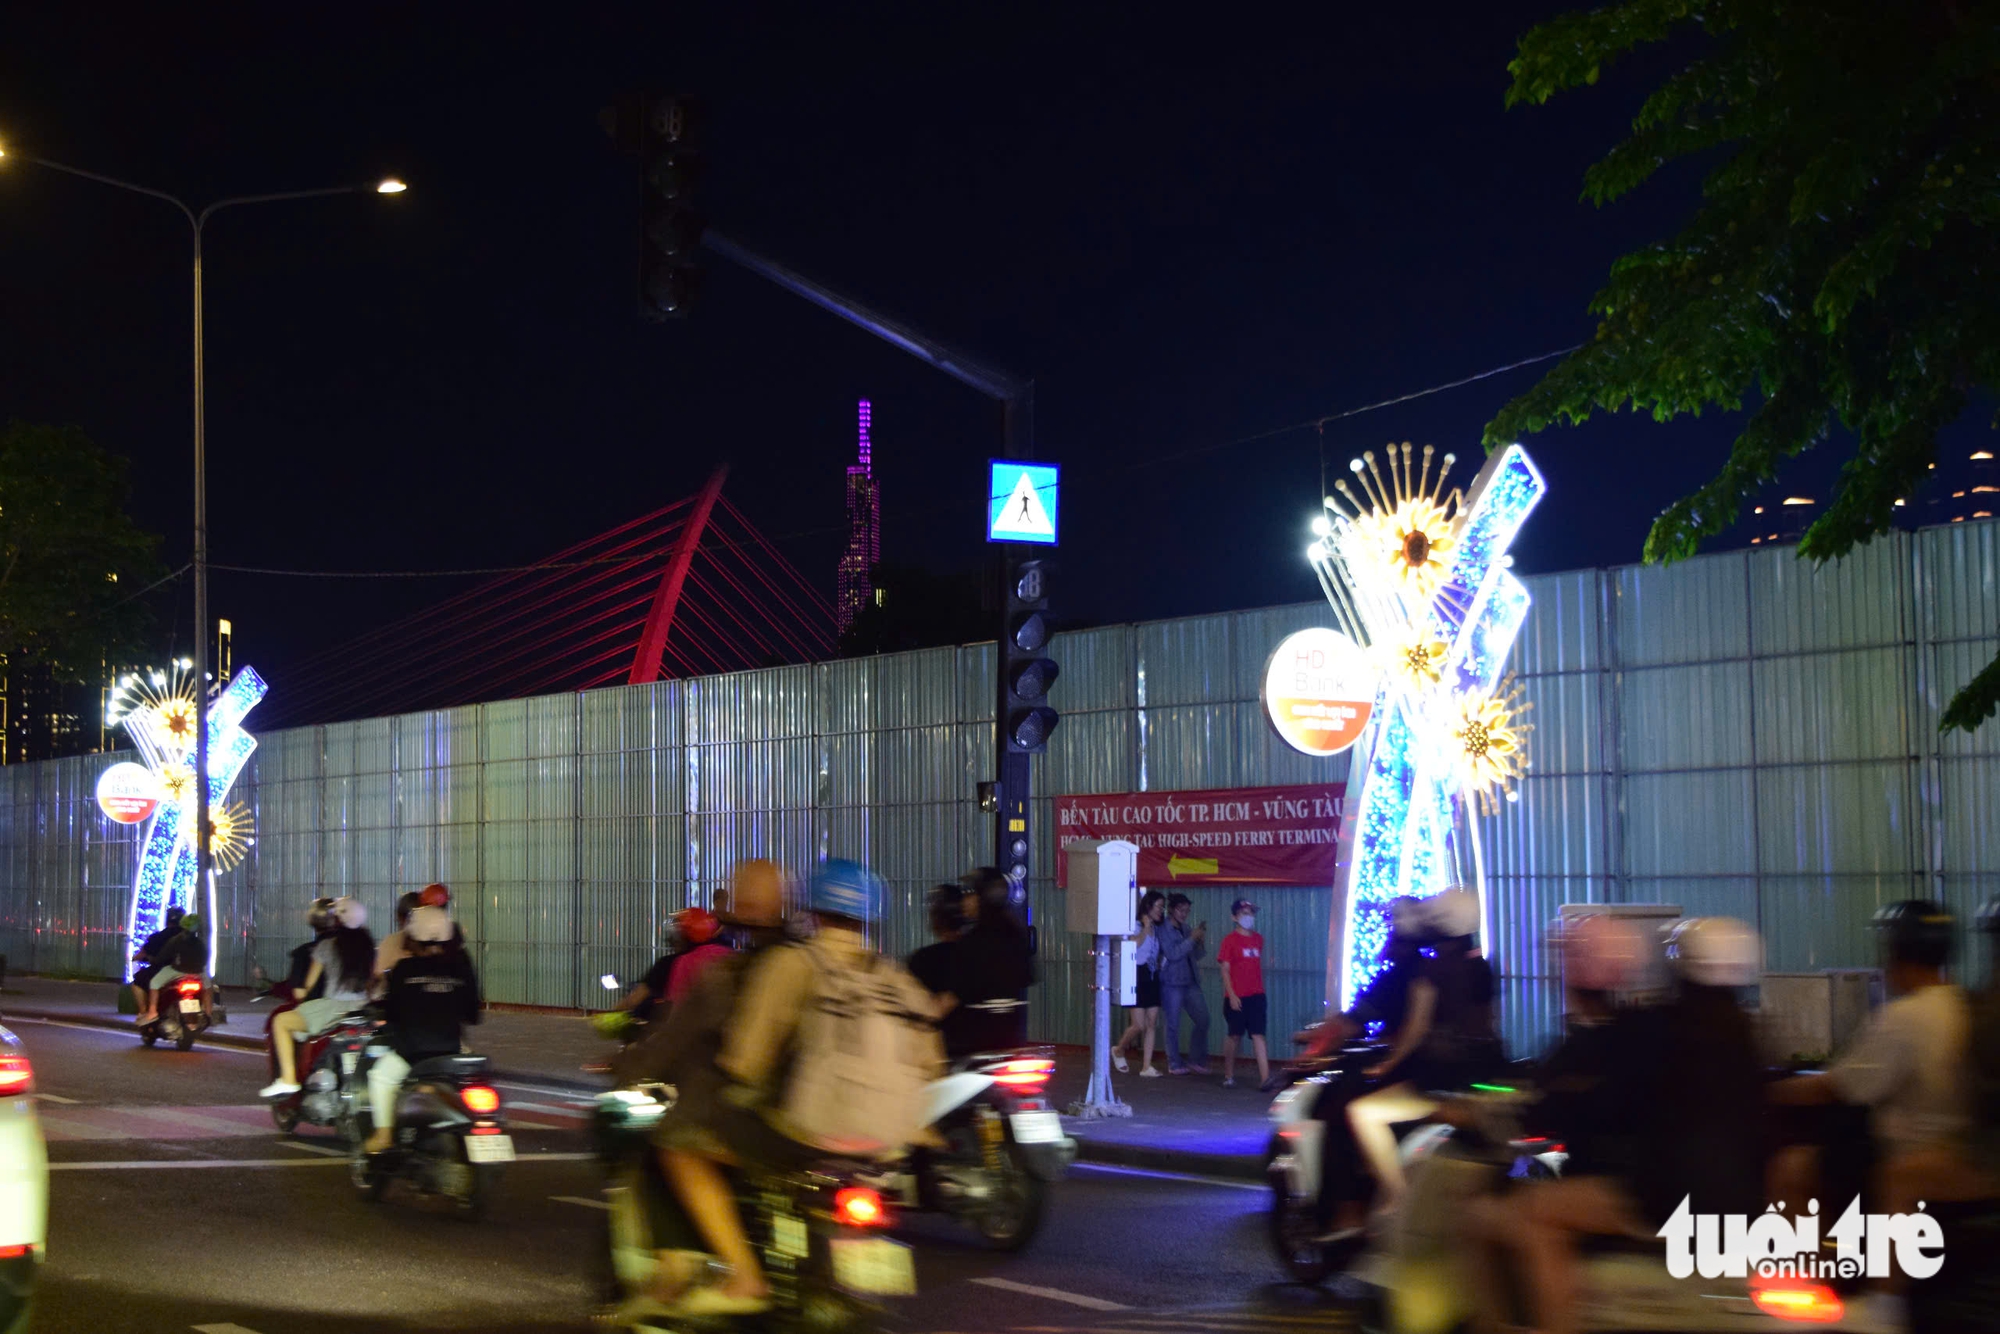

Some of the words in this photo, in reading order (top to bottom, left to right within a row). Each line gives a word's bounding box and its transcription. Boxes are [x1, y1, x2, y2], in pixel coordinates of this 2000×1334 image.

[1295, 649, 1325, 669] HD
[1295, 671, 1345, 694] Bank
[1061, 799, 1088, 826] BẾN
[1092, 802, 1119, 825] TÀU
[1123, 805, 1151, 824] CAO
[1155, 795, 1186, 823] TỐC
[1189, 804, 1210, 822] TP.
[1213, 802, 1250, 821] HCM
[1263, 795, 1309, 819] VŨNG
[1312, 792, 1344, 818] TÀU
[1134, 833, 1155, 848] TAU
[1158, 831, 1231, 848] HIGH-SPEED
[1235, 830, 1275, 846] FERRY
[1278, 827, 1339, 845] TERMINA
